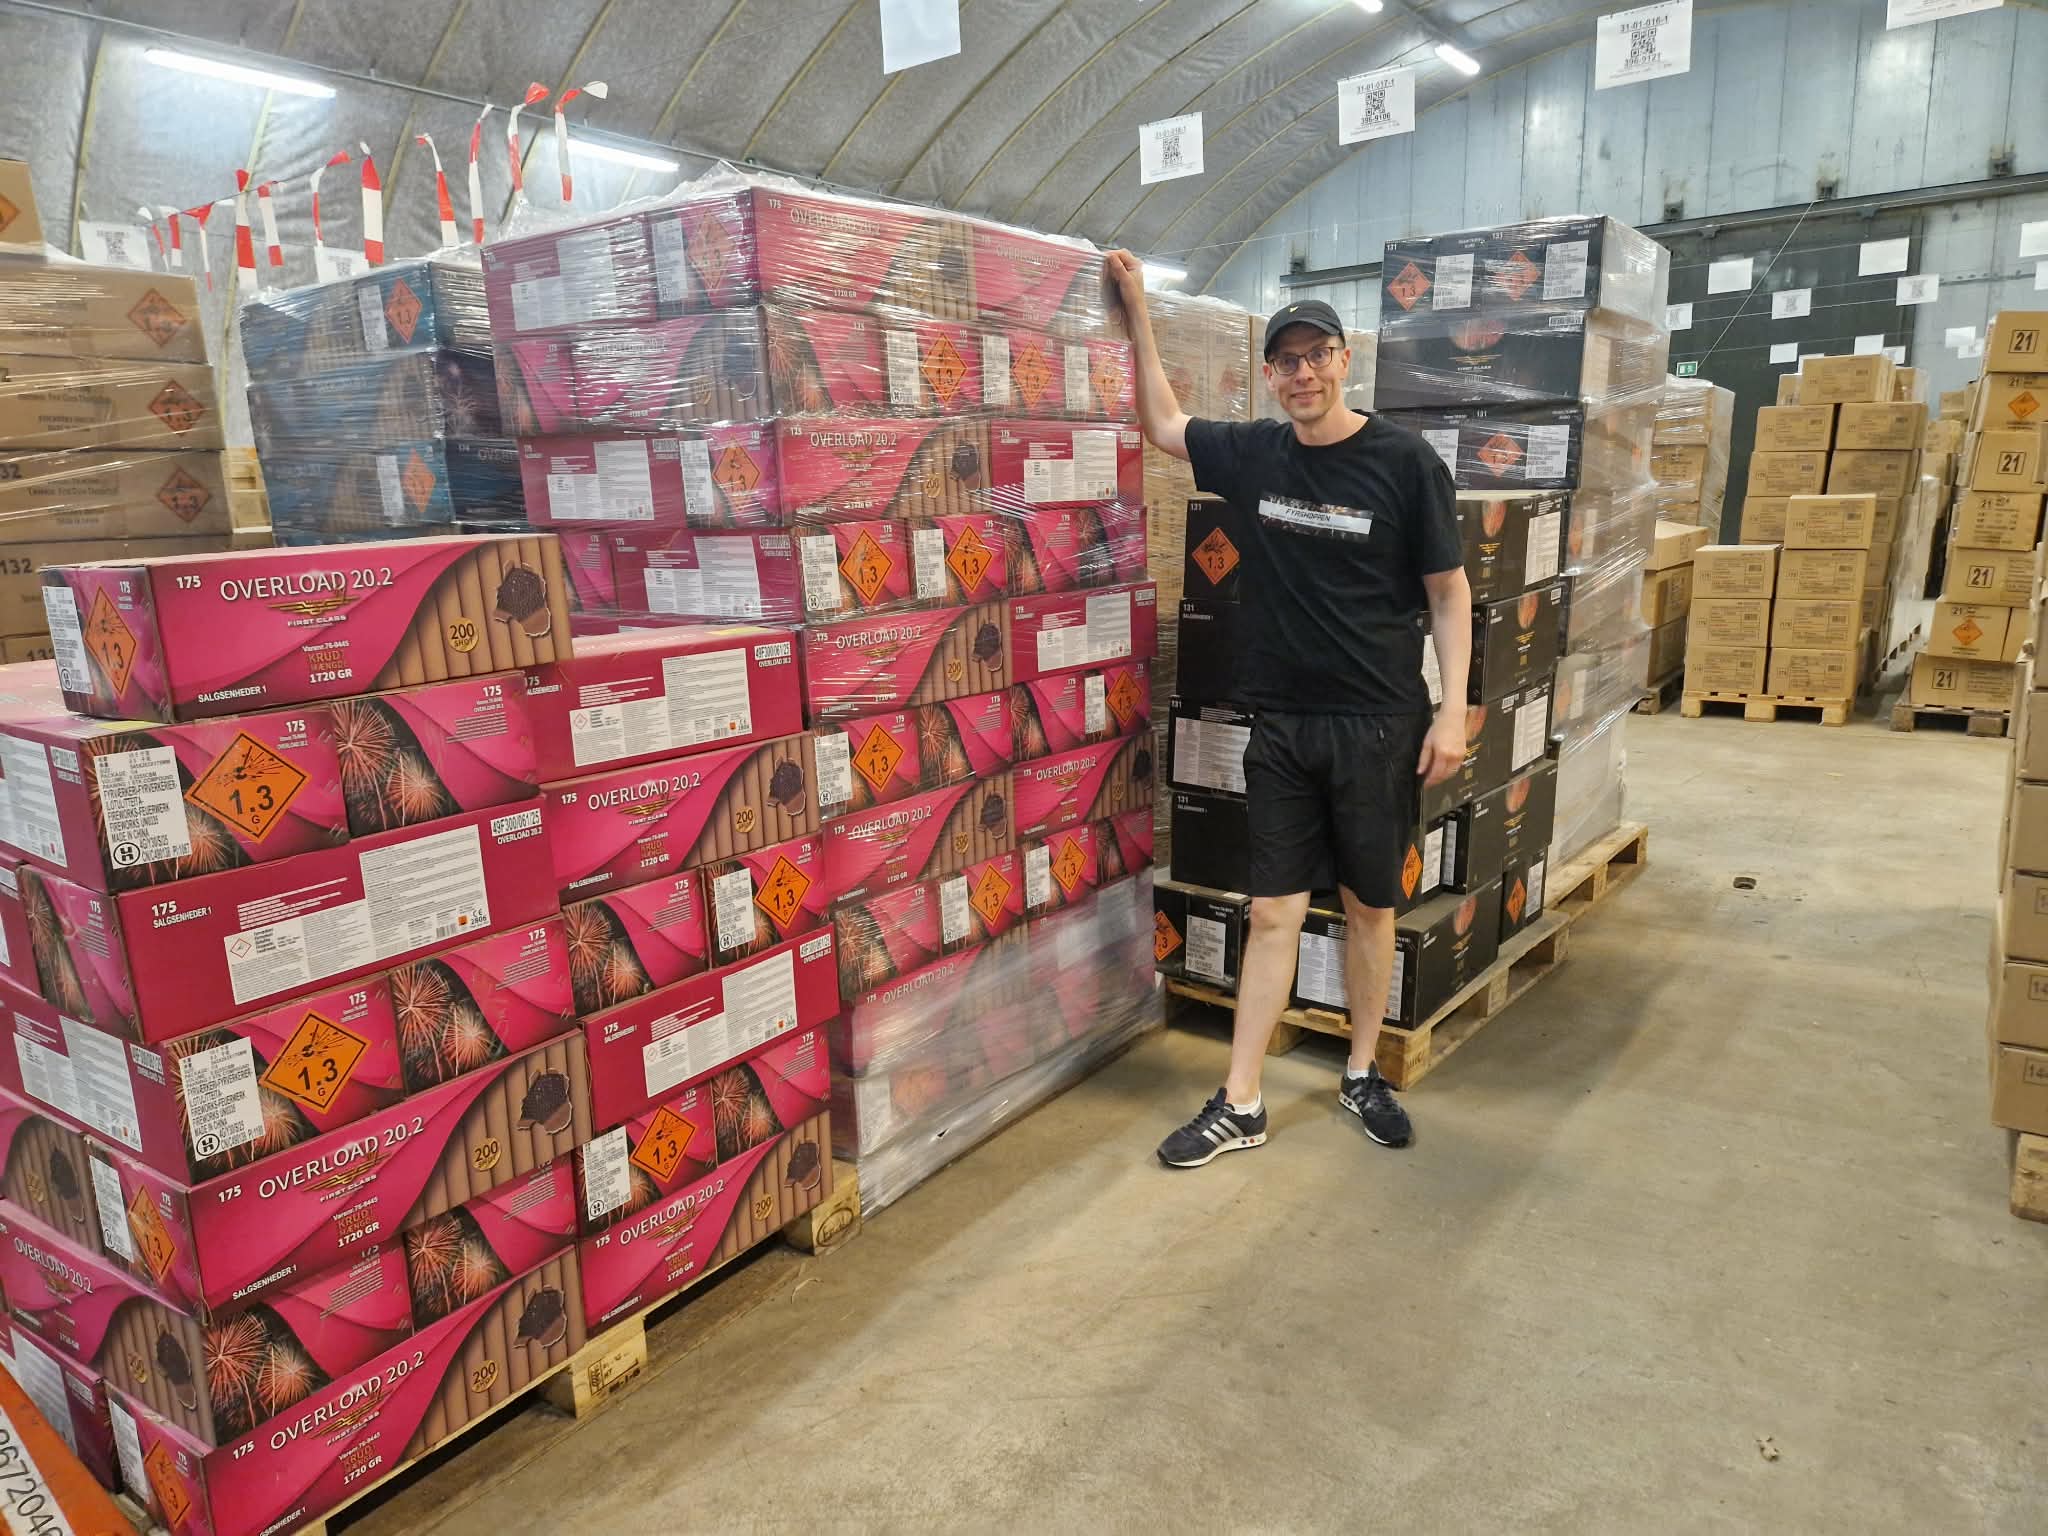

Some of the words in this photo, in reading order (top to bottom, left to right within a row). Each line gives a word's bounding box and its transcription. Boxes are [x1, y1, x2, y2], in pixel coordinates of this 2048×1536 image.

[768, 199, 782, 209] 175
[1401, 286, 1417, 297] 1.3
[2014, 332, 2033, 351] 21
[2009, 377, 2020, 387] 21
[810, 431, 873, 448] OVERLOAD
[875, 432, 897, 447] 20.2
[2002, 454, 2020, 473] 21
[1191, 503, 1202, 511] 131
[1981, 499, 1994, 509] 21
[883, 525, 893, 533] 175
[985, 520, 994, 528] 175
[961, 558, 981, 576] 1.3
[1207, 556, 1225, 569] 1.3
[176, 576, 201, 589] 175
[859, 566, 878, 585] 1.3
[1970, 568, 1989, 586] 21
[220, 572, 346, 602] OVERLOAD
[351, 567, 393, 590] 20.2
[1183, 603, 1195, 612] 131
[1953, 607, 1963, 616] 21
[450, 623, 475, 640] 200
[836, 627, 899, 650] OVERLOAD
[900, 625, 922, 641] 20.2
[100, 641, 125, 669] 1.3
[309, 670, 336, 684] 1720
[337, 669, 353, 680] GR
[948, 662, 962, 676] 200
[1936, 672, 1953, 688] 21
[198, 686, 262, 703] SALGSENHEDER
[261, 686, 267, 694] 1
[482, 685, 502, 697] 175
[991, 696, 1001, 704] 175
[1118, 695, 1133, 710] 1.3
[286, 720, 306, 732] 175
[895, 716, 905, 724] 175
[868, 755, 889, 775] 1.3
[1036, 762, 1080, 782] OVERLOAD
[1080, 756, 1097, 771] 20.2
[229, 784, 275, 815] 1.3
[561, 793, 578, 805] 175
[587, 780, 669, 811] OVERLOAD
[672, 772, 701, 790] 20.2
[1177, 795, 1189, 804] 131
[251, 815, 260, 824] G
[736, 809, 754, 824] 200
[852, 812, 909, 838] OVERLOAD
[911, 805, 932, 823] 20.2
[834, 825, 845, 835] 175
[802, 843, 812, 853] 175
[640, 857, 658, 869] 1720
[658, 854, 670, 863] GR
[1063, 863, 1077, 880] 1.3
[674, 879, 689, 890] 175
[915, 887, 925, 896] 175
[773, 889, 796, 911] 1.3
[983, 893, 1000, 910] 1.3
[151, 901, 177, 917] 175
[152, 907, 208, 929] SALGSENHEDER
[208, 906, 213, 915] 1
[528, 927, 546, 941] 175
[882, 971, 935, 1004] OVERLOAD
[936, 962, 955, 983] 20.2
[349, 992, 367, 1006] 175
[604, 1021, 620, 1035] 175
[801, 1032, 814, 1043] 175
[298, 1058, 338, 1091] 1.3
[317, 1087, 326, 1097] G
[685, 1088, 696, 1099] 175
[258, 1136, 379, 1200] OVERLOAD
[383, 1116, 425, 1149] 20.2
[475, 1141, 499, 1161] 200
[653, 1140, 678, 1165] 1.3
[218, 1185, 242, 1203] 175
[619, 1194, 696, 1246] OVERLOAD
[697, 1179, 725, 1205] 20.2
[754, 1197, 772, 1214] 200
[337, 1230, 363, 1249] 1720
[363, 1221, 381, 1236] GR
[595, 1233, 611, 1249] 175
[14, 1237, 69, 1280] OVERLOAD
[71, 1268, 94, 1294] 20.2
[667, 1266, 685, 1282] 1720
[684, 1261, 694, 1273] GR
[232, 1265, 293, 1300] SALGSENHEDER
[292, 1263, 298, 1272] 1
[472, 1362, 497, 1385] 200
[270, 1376, 382, 1450] OVERLOAD
[386, 1350, 425, 1384] 20.2
[232, 1440, 256, 1461] 175
[343, 1465, 368, 1485] 1720
[367, 1454, 383, 1471] GR
